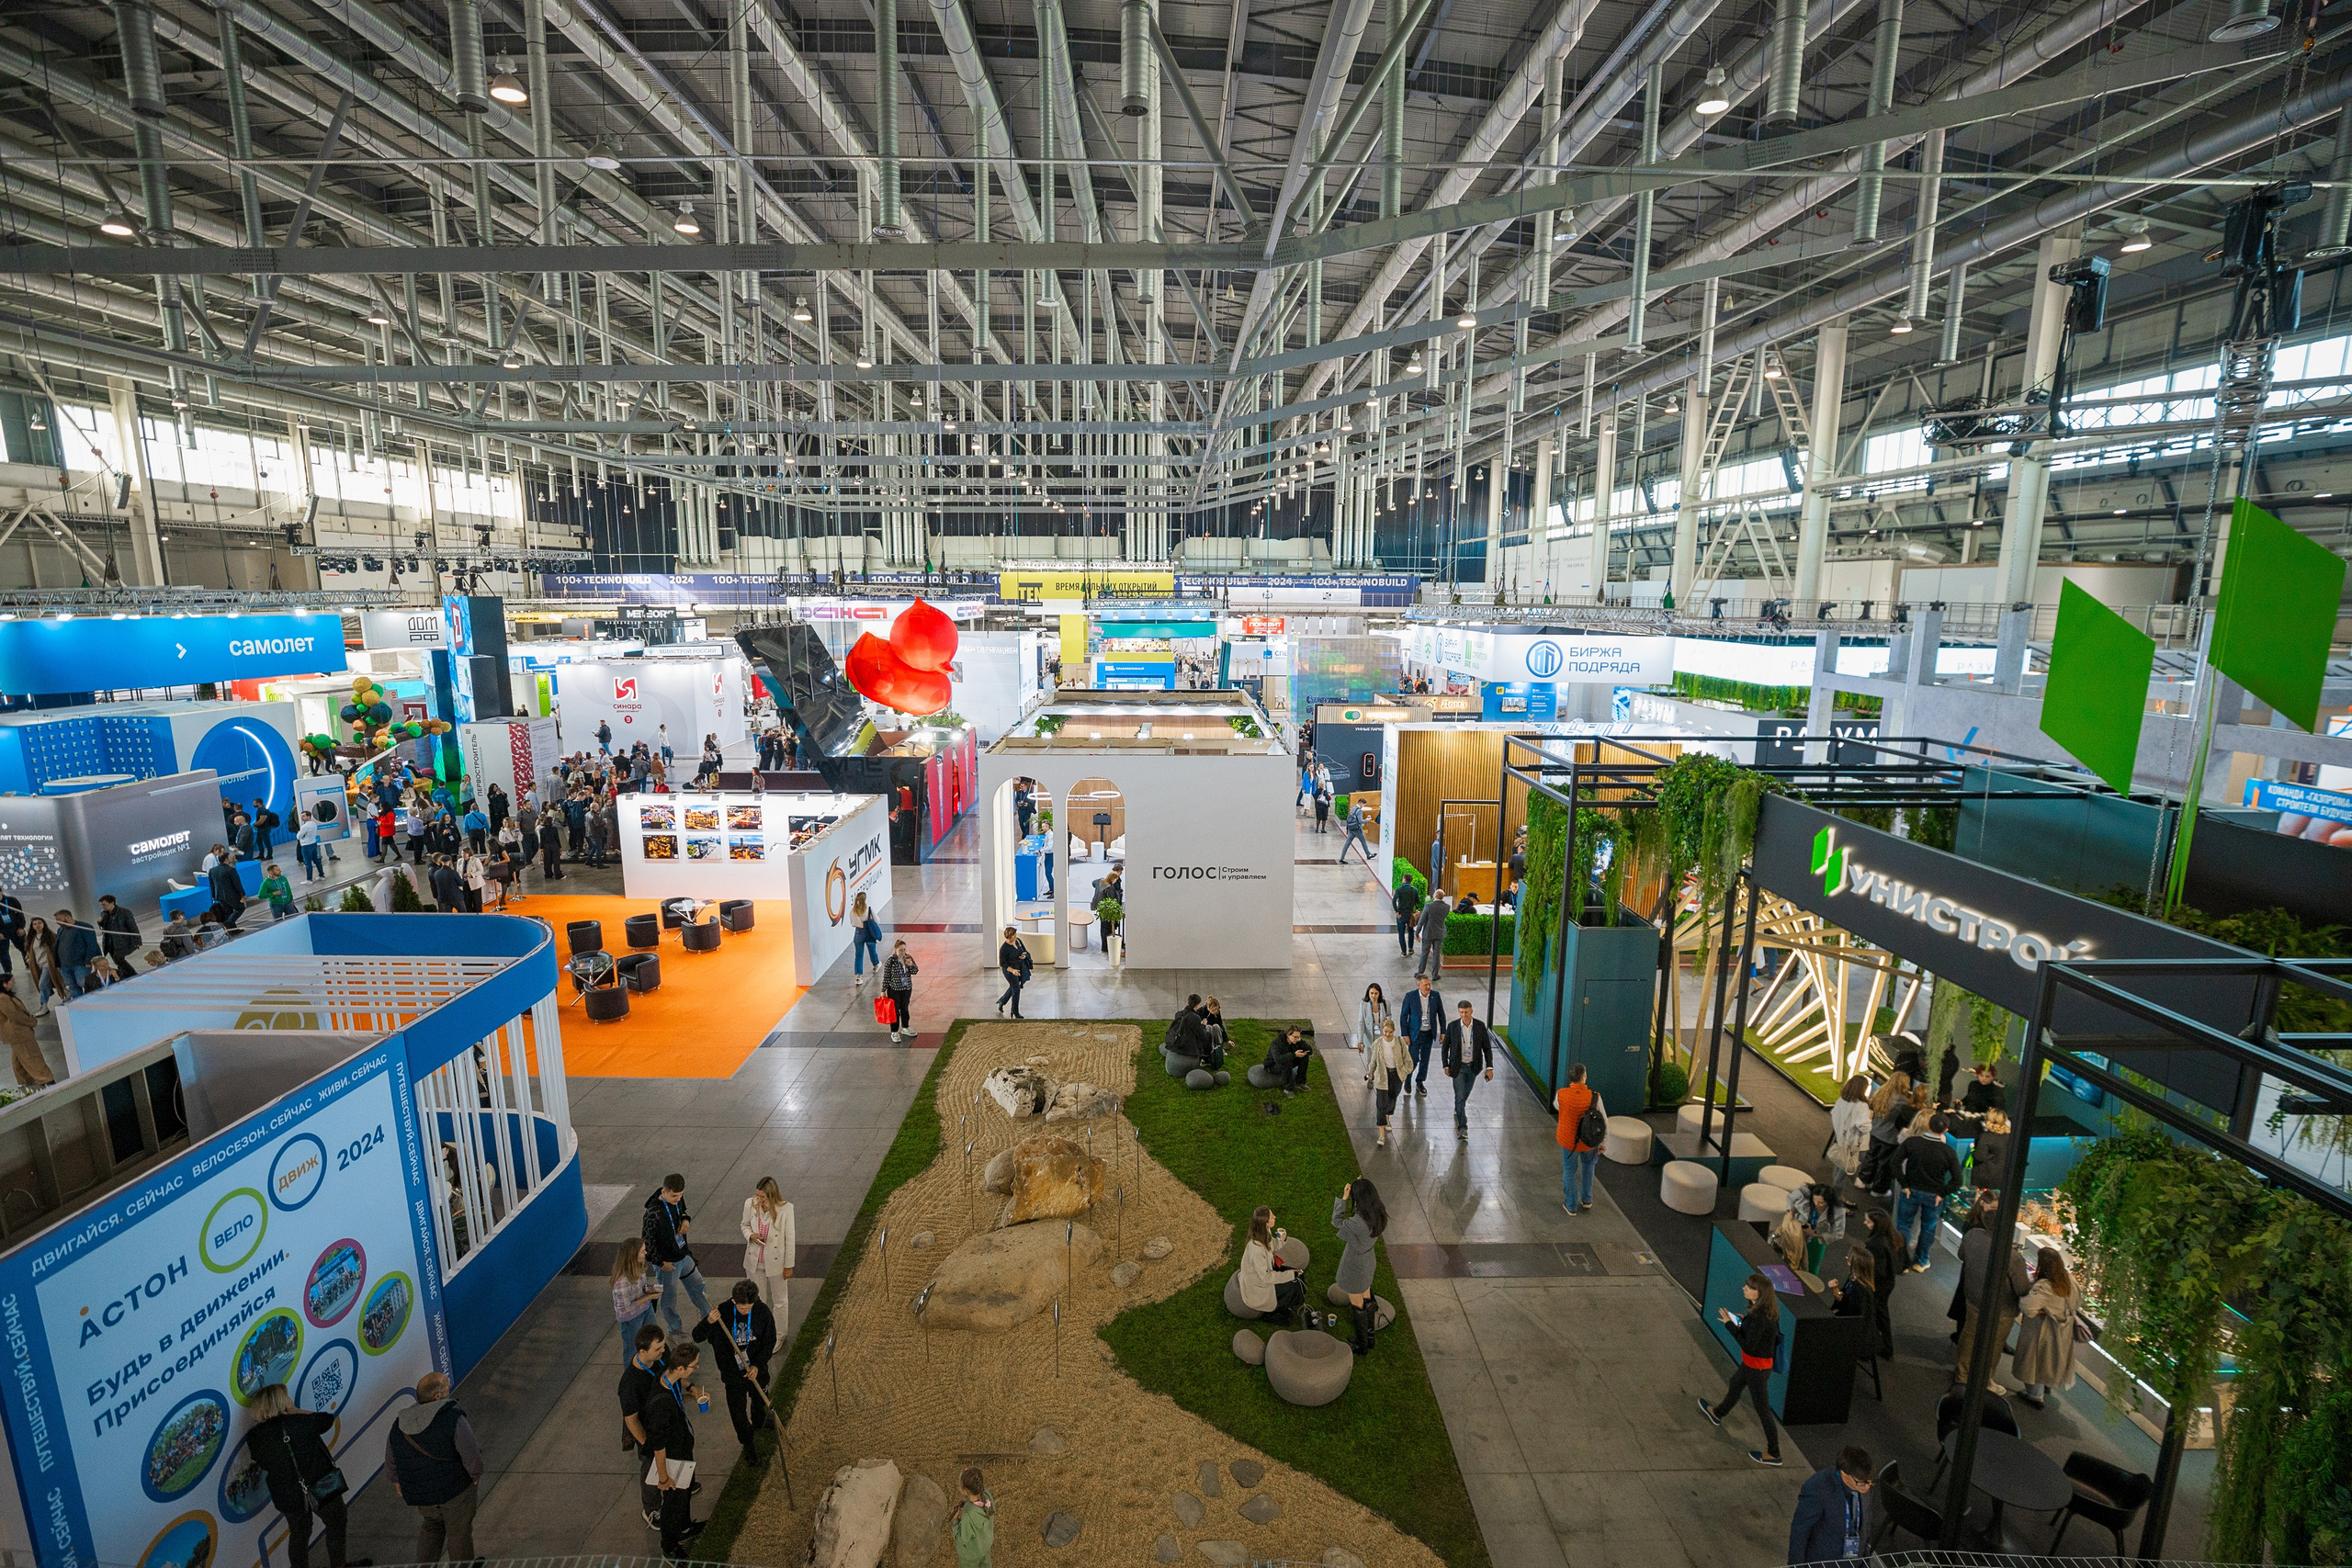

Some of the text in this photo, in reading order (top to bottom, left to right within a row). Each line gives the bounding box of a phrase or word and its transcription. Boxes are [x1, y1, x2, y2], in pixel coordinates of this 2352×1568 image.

[555, 576, 651, 585] 100+ TECHNOBUILD
[670, 576, 695, 585] 2024
[712, 576, 739, 585] 100+
[1056, 582, 1080, 591] ВРЕМЯ
[1119, 581, 1158, 591] ОТКРЫТИЙ
[1268, 577, 1293, 587] 2024
[1339, 578, 1408, 587] TECHNOBUILD
[408, 616, 438, 631] ДОМ
[230, 636, 314, 657] самолет
[410, 634, 439, 642] РФ
[1569, 647, 1622, 658] БИРЖА
[1568, 661, 1640, 674] ПОДРЯДА
[613, 703, 642, 713] синара
[1442, 699, 1466, 712] Дома
[1775, 727, 1880, 751] РАУМ
[471, 733, 483, 797] ПЕРВОСТРОИТЕЛЬ
[2267, 785, 2304, 800] КОМАНДА
[2276, 797, 2320, 814] СТРОИТЕЛИ
[130, 830, 191, 855] самолет
[131, 848, 177, 864] застройщик
[848, 832, 881, 880] УГМК
[1152, 866, 1217, 880] ГОЛОС
[318, 1054, 388, 1102] ЖИВИ. СЕЙЧАС
[191, 1098, 313, 1178] ВЕЛОСЕЗОН. СЕЙЧАС
[336, 1123, 386, 1172] 2024
[278, 1154, 320, 1194] ДВИЖ
[31, 1175, 185, 1278] ДВИГАЙСЯ. СЕЙЧАС
[213, 1213, 254, 1250] ВЕЛО
[414, 1199, 438, 1300] ДВИГАЙСЯ. СЕЙЧАС
[79, 1255, 189, 1350] АСТОН
[86, 1248, 290, 1407] Будь в движении.
[93, 1286, 277, 1438] Присоединяйся
[47, 1486, 73, 1551] СЕЙЧАС
